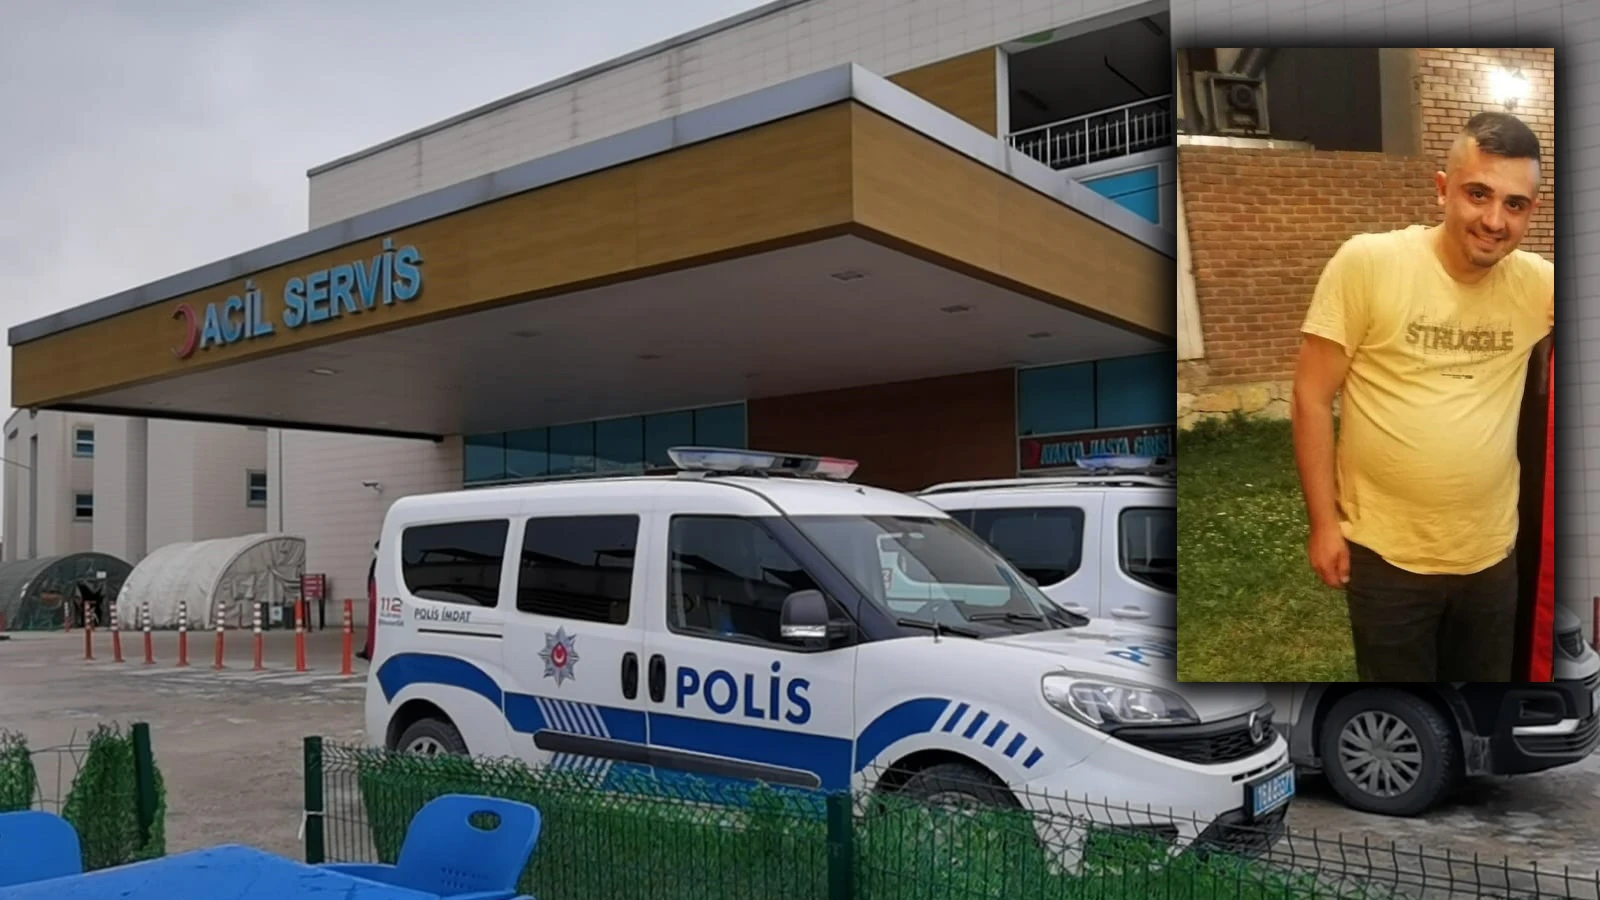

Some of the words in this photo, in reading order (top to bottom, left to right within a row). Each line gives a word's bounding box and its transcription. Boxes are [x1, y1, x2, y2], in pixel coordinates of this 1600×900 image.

[201, 279, 274, 348] ACİL
[283, 237, 422, 329] SERVİS
[1405, 321, 1514, 352] STRUGGLE
[381, 597, 403, 612] 112
[414, 606, 440, 621] POLİS
[441, 606, 471, 623] İMDAT
[676, 660, 812, 725] POLİS
